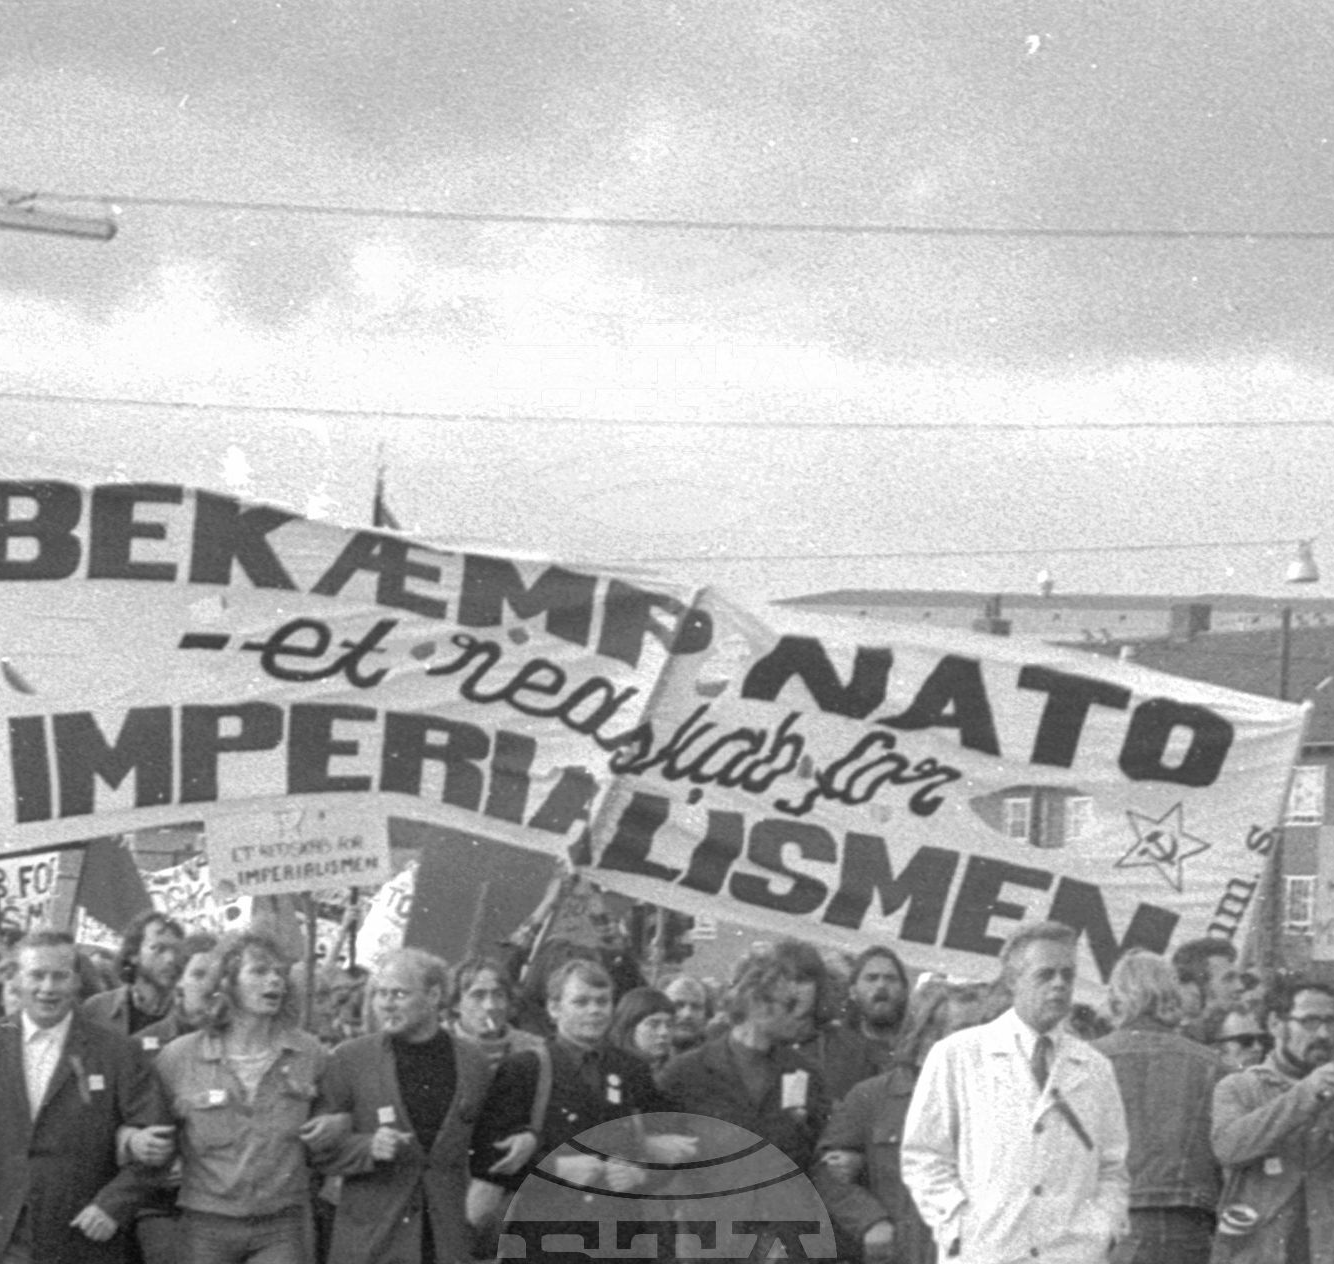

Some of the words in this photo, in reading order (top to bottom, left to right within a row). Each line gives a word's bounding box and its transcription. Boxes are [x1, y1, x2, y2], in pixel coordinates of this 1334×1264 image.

[742, 635, 1234, 788] NATO
[775, 731, 962, 817] for
[8, 702, 1180, 985] IMPERIALISMEN
[237, 857, 379, 885] IMPERIALISMEN
